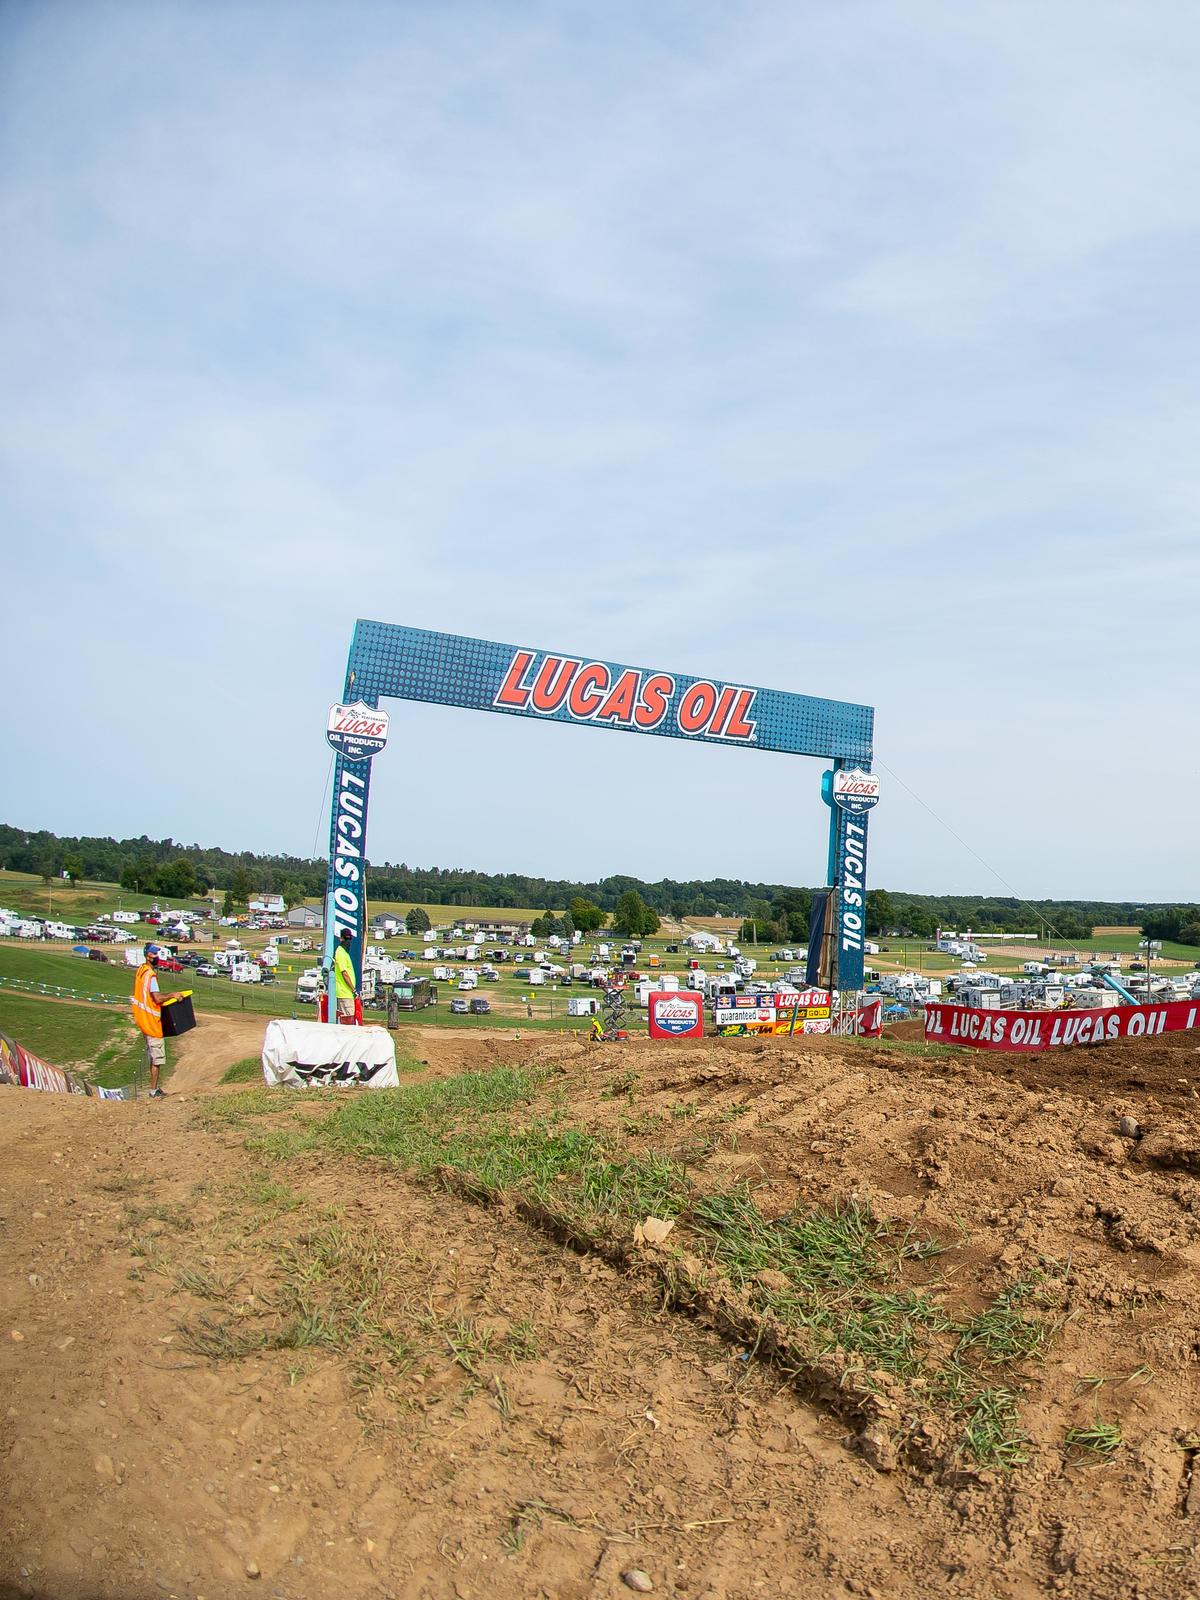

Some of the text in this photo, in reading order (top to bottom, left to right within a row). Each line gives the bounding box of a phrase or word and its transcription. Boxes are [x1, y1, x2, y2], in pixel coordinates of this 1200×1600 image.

[493, 650, 757, 742] LUCAS OIL
[334, 718, 386, 736] LUCAS
[329, 733, 384, 748] OIL PRODUCTS
[348, 746, 363, 755] INC.
[839, 781, 878, 795] LUCAS
[847, 795, 878, 804] PRODUCTS
[334, 770, 365, 882] LUCAS
[842, 821, 865, 951] LUCAS OIL
[779, 994, 811, 1006] LUCAS
[812, 993, 827, 1005] OIL
[661, 1009, 693, 1018] LUCAS
[720, 1010, 757, 1024] guaranteed
[808, 1009, 828, 1017] GOLD
[951, 1012, 1007, 1043] LUCAS
[1010, 1017, 1042, 1046] OIL
[1050, 1014, 1121, 1046] LUCAS
